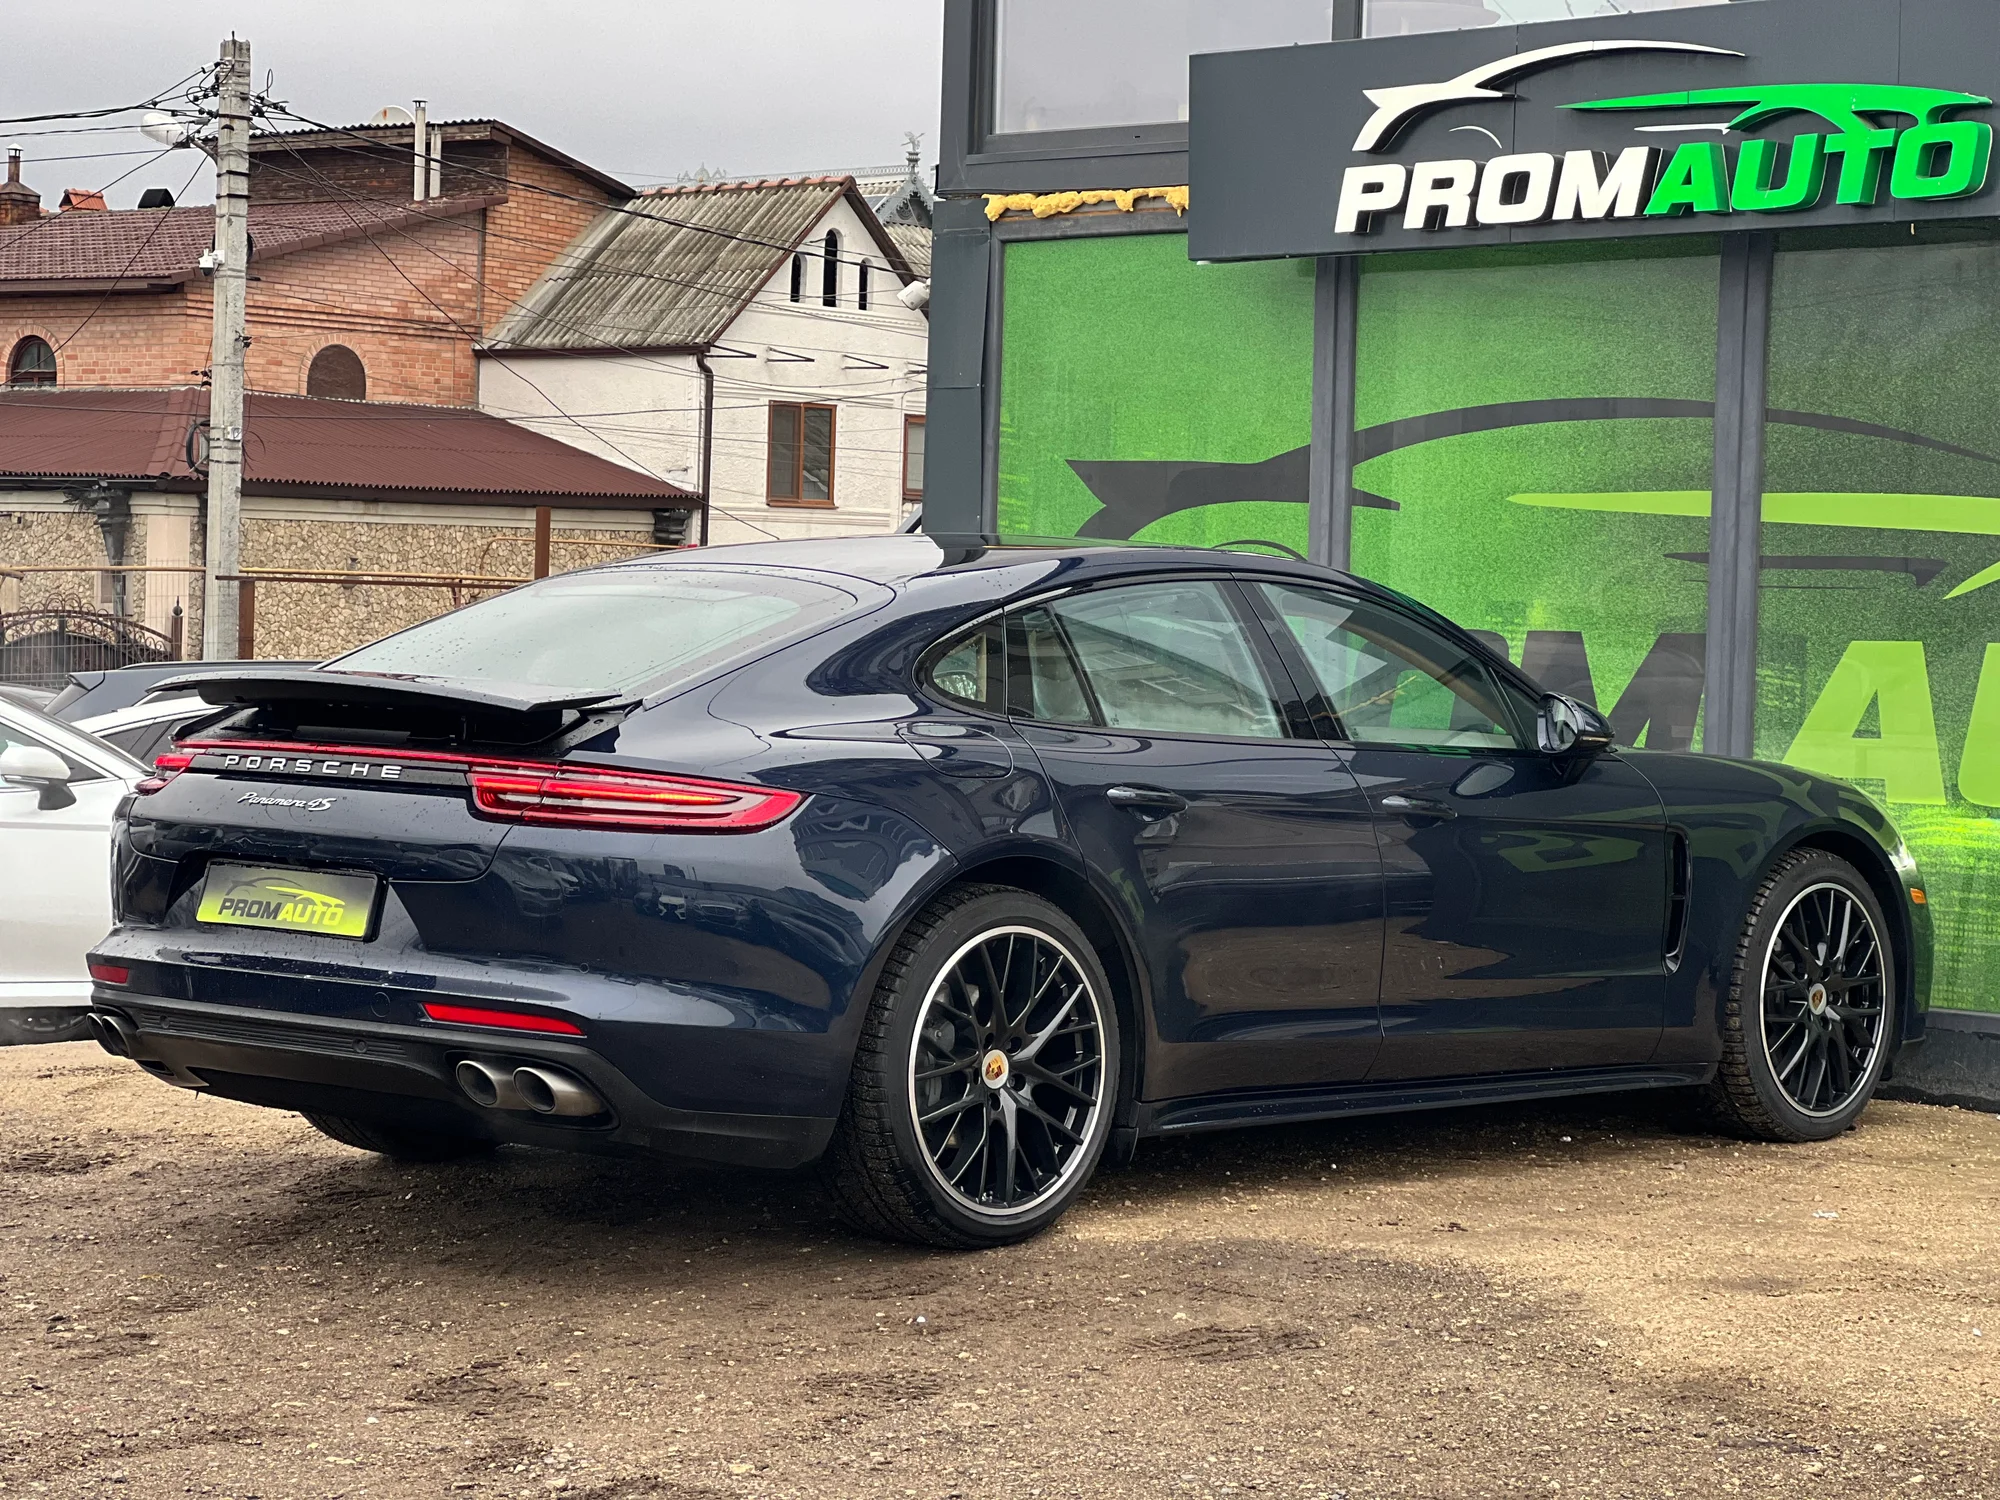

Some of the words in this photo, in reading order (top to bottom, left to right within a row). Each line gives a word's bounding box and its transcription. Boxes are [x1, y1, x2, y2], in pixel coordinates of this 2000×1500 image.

[1334, 119, 1992, 234] PROMAUTO
[224, 754, 402, 780] PORSCHE
[237, 791, 306, 808] Panamera
[307, 797, 337, 812] 4S
[217, 897, 345, 926] PROMAUTO
